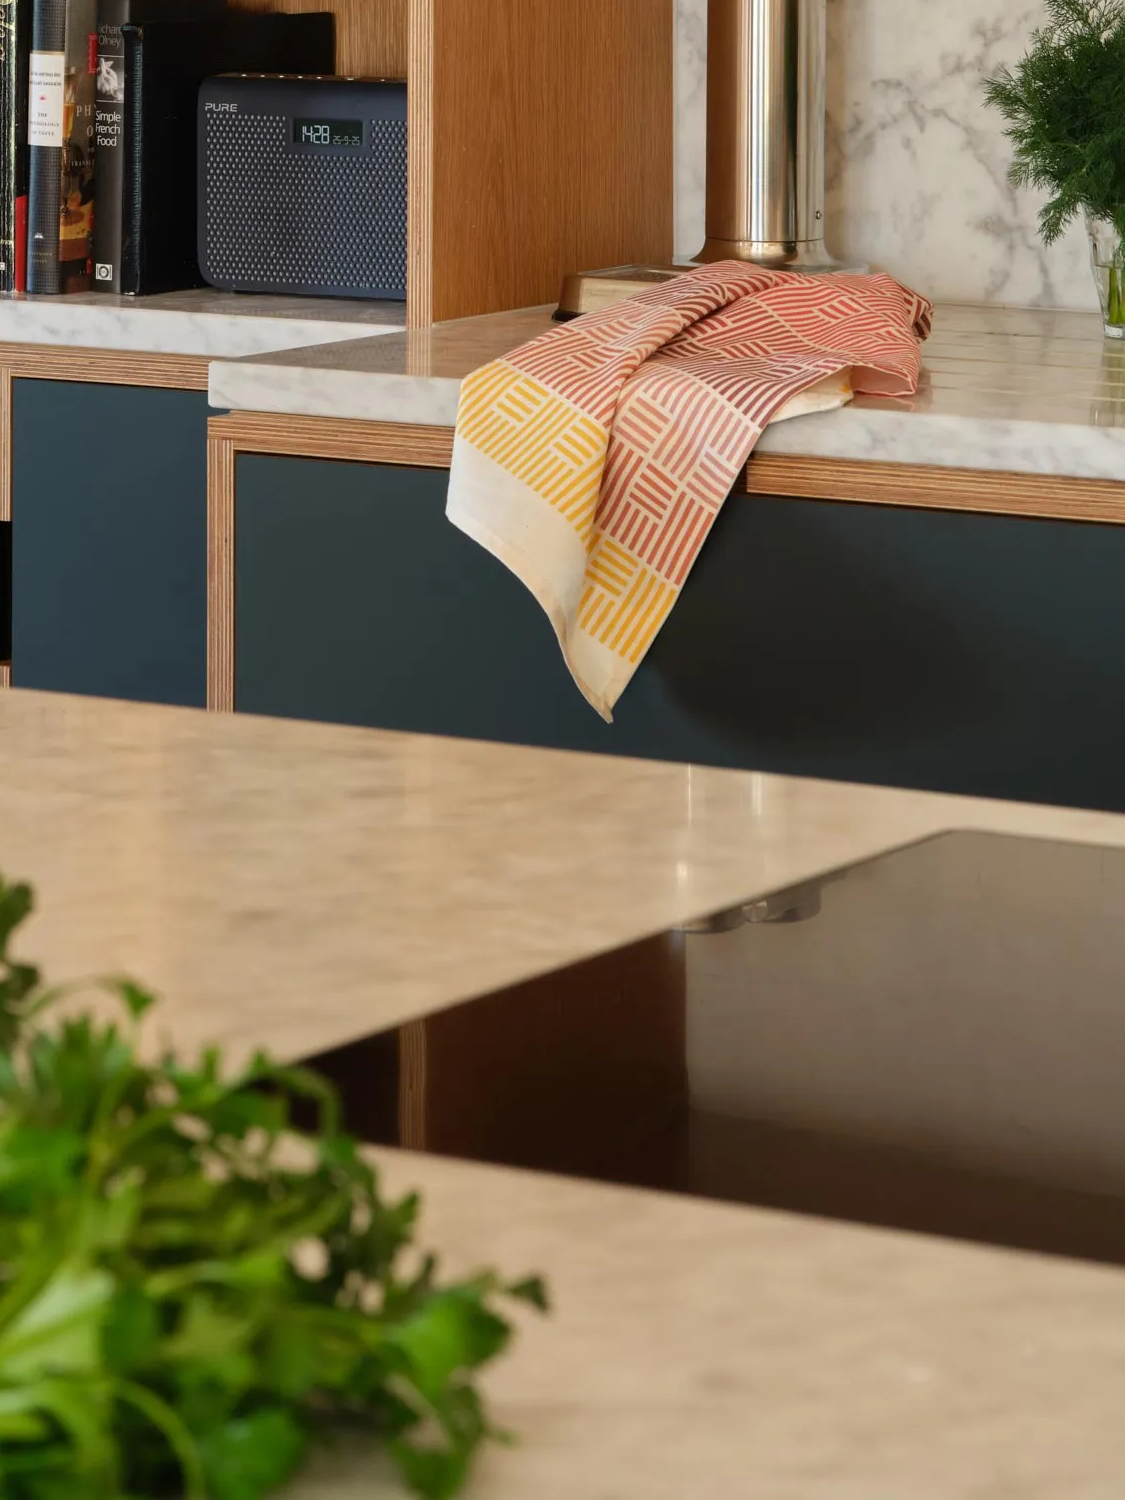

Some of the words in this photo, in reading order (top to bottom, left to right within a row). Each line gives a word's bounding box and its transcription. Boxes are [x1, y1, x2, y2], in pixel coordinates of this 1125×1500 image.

[98, 35, 122, 49] Olney
[205, 103, 238, 112] PURE
[95, 110, 122, 124] Simple
[95, 123, 121, 135] French
[97, 135, 117, 147] Food
